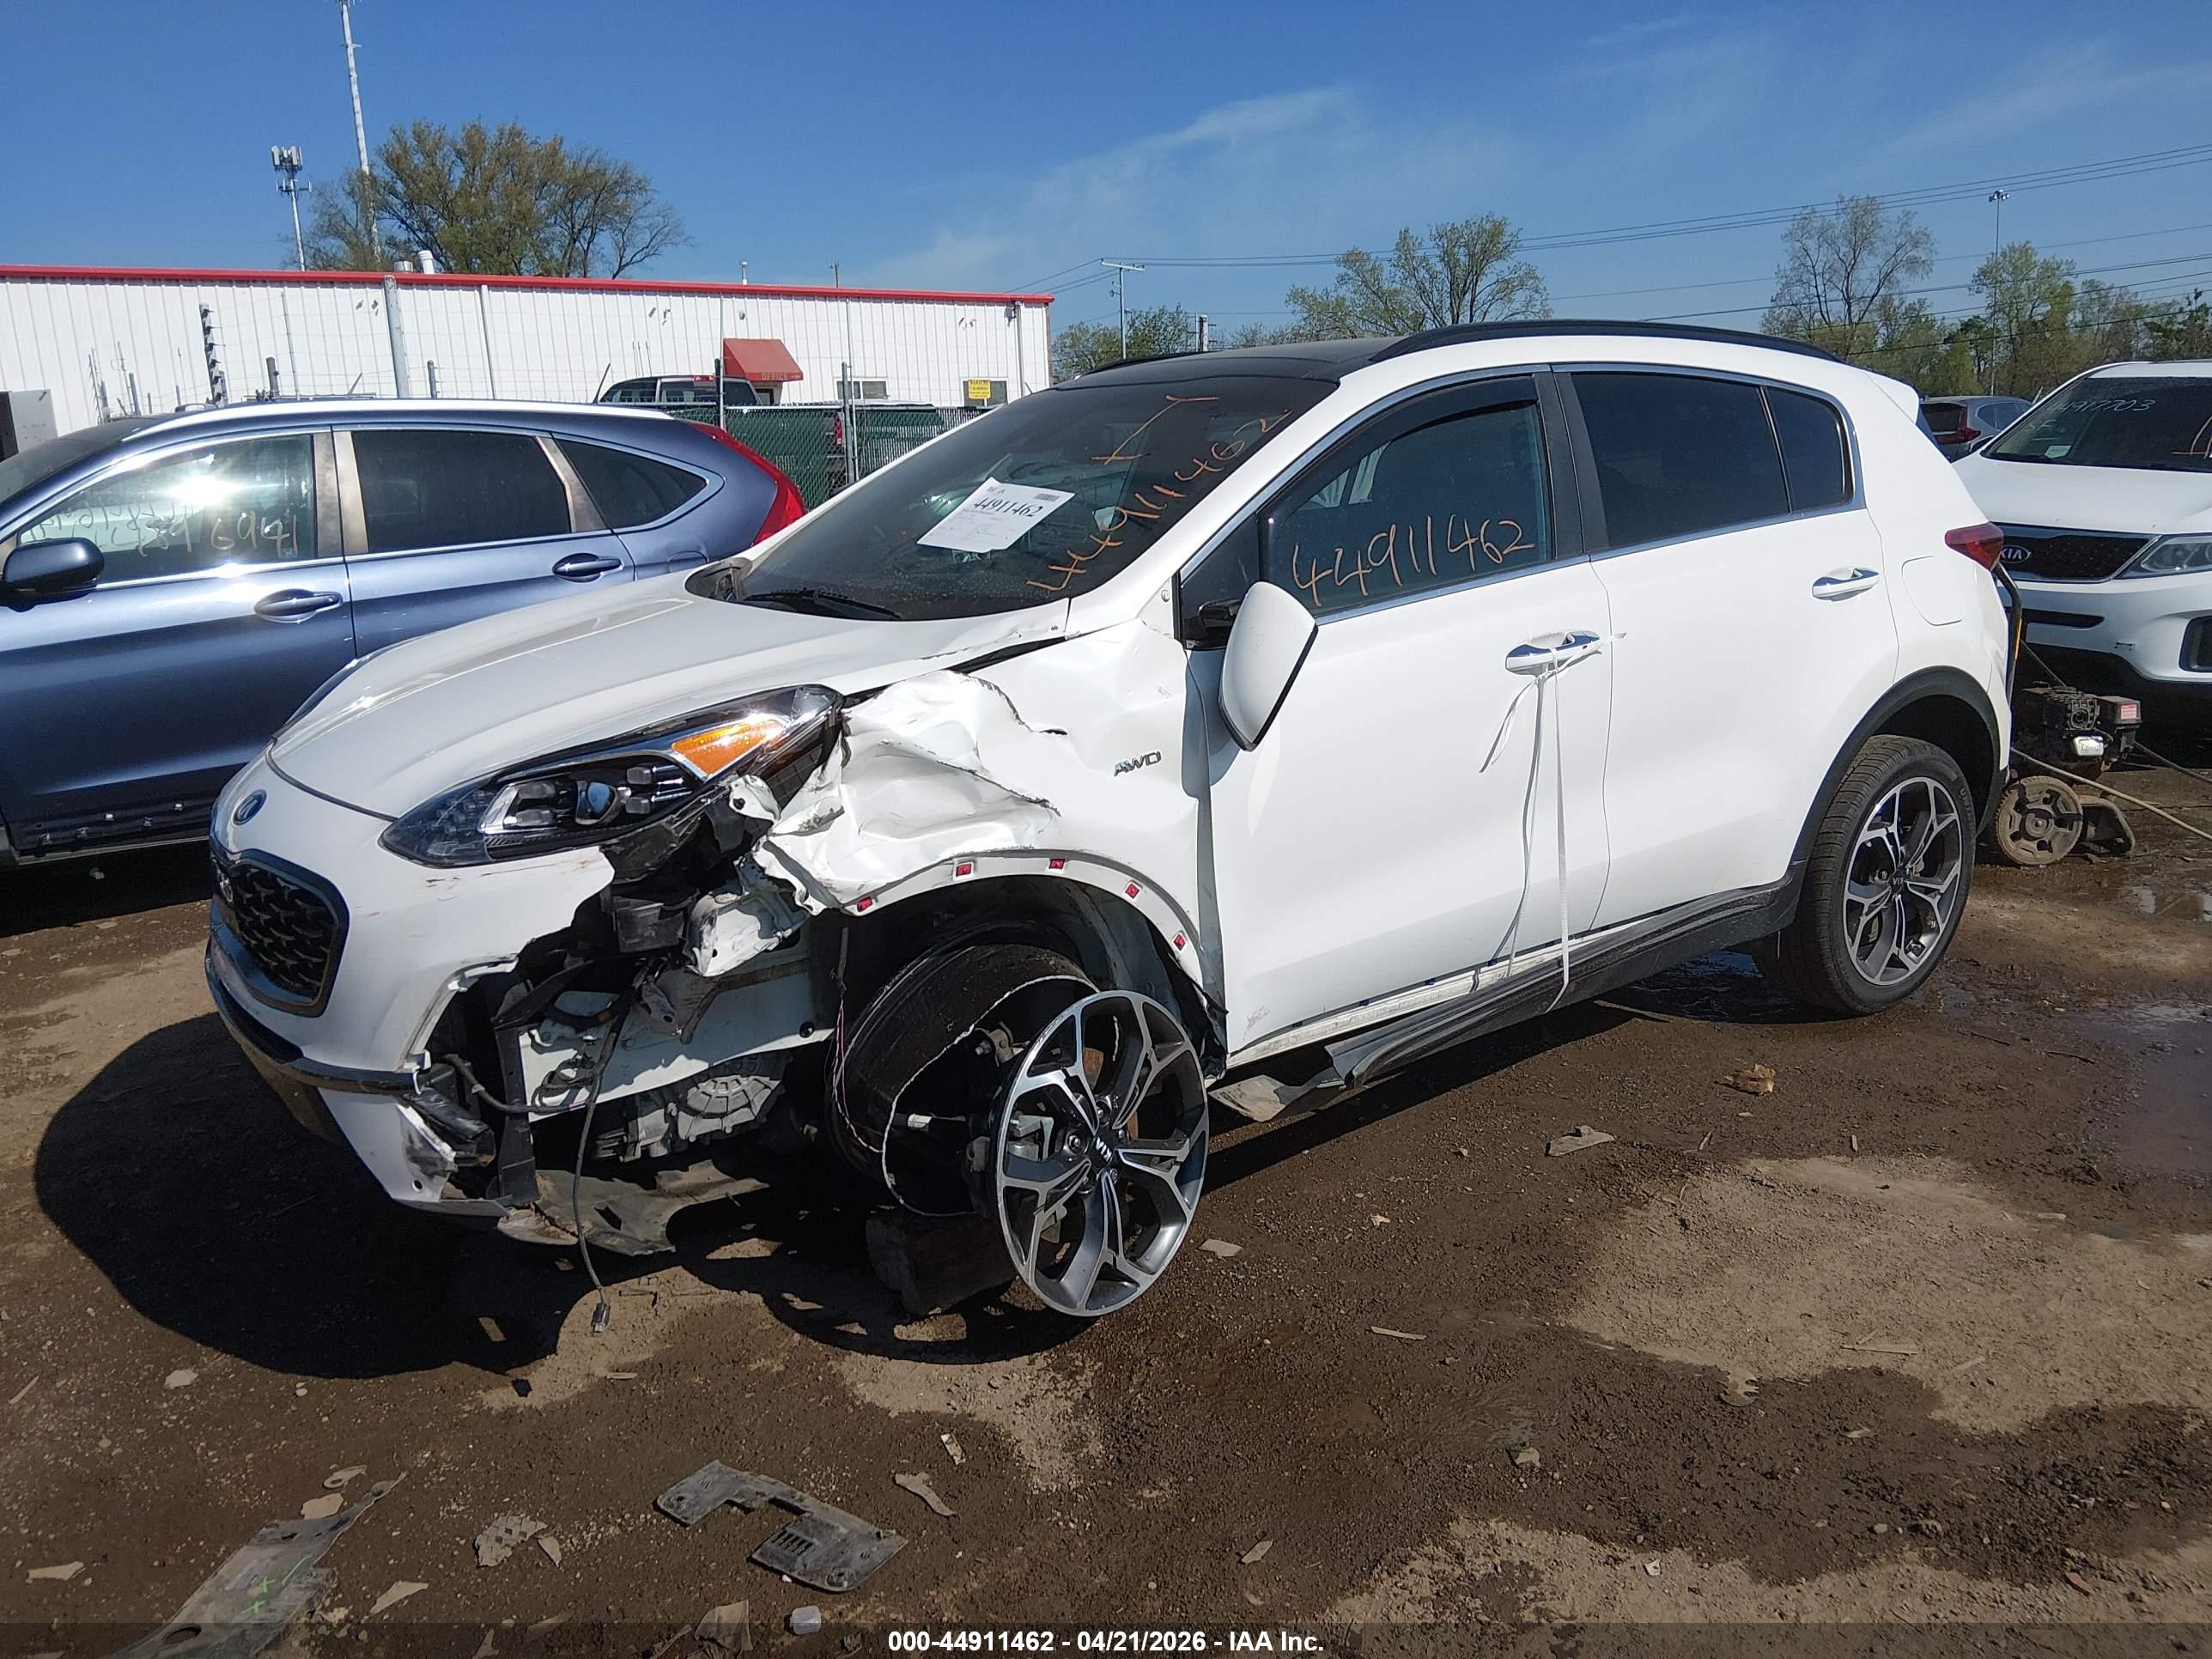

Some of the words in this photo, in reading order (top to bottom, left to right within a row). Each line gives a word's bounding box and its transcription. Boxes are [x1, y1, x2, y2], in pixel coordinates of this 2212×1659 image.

[973, 497, 1044, 517] 44911462
[1025, 410, 1293, 591] 44911462
[1291, 514, 1535, 606] 44911462
[1114, 750, 1162, 777] AWD
[1095, 1136, 1113, 1163] KIA
